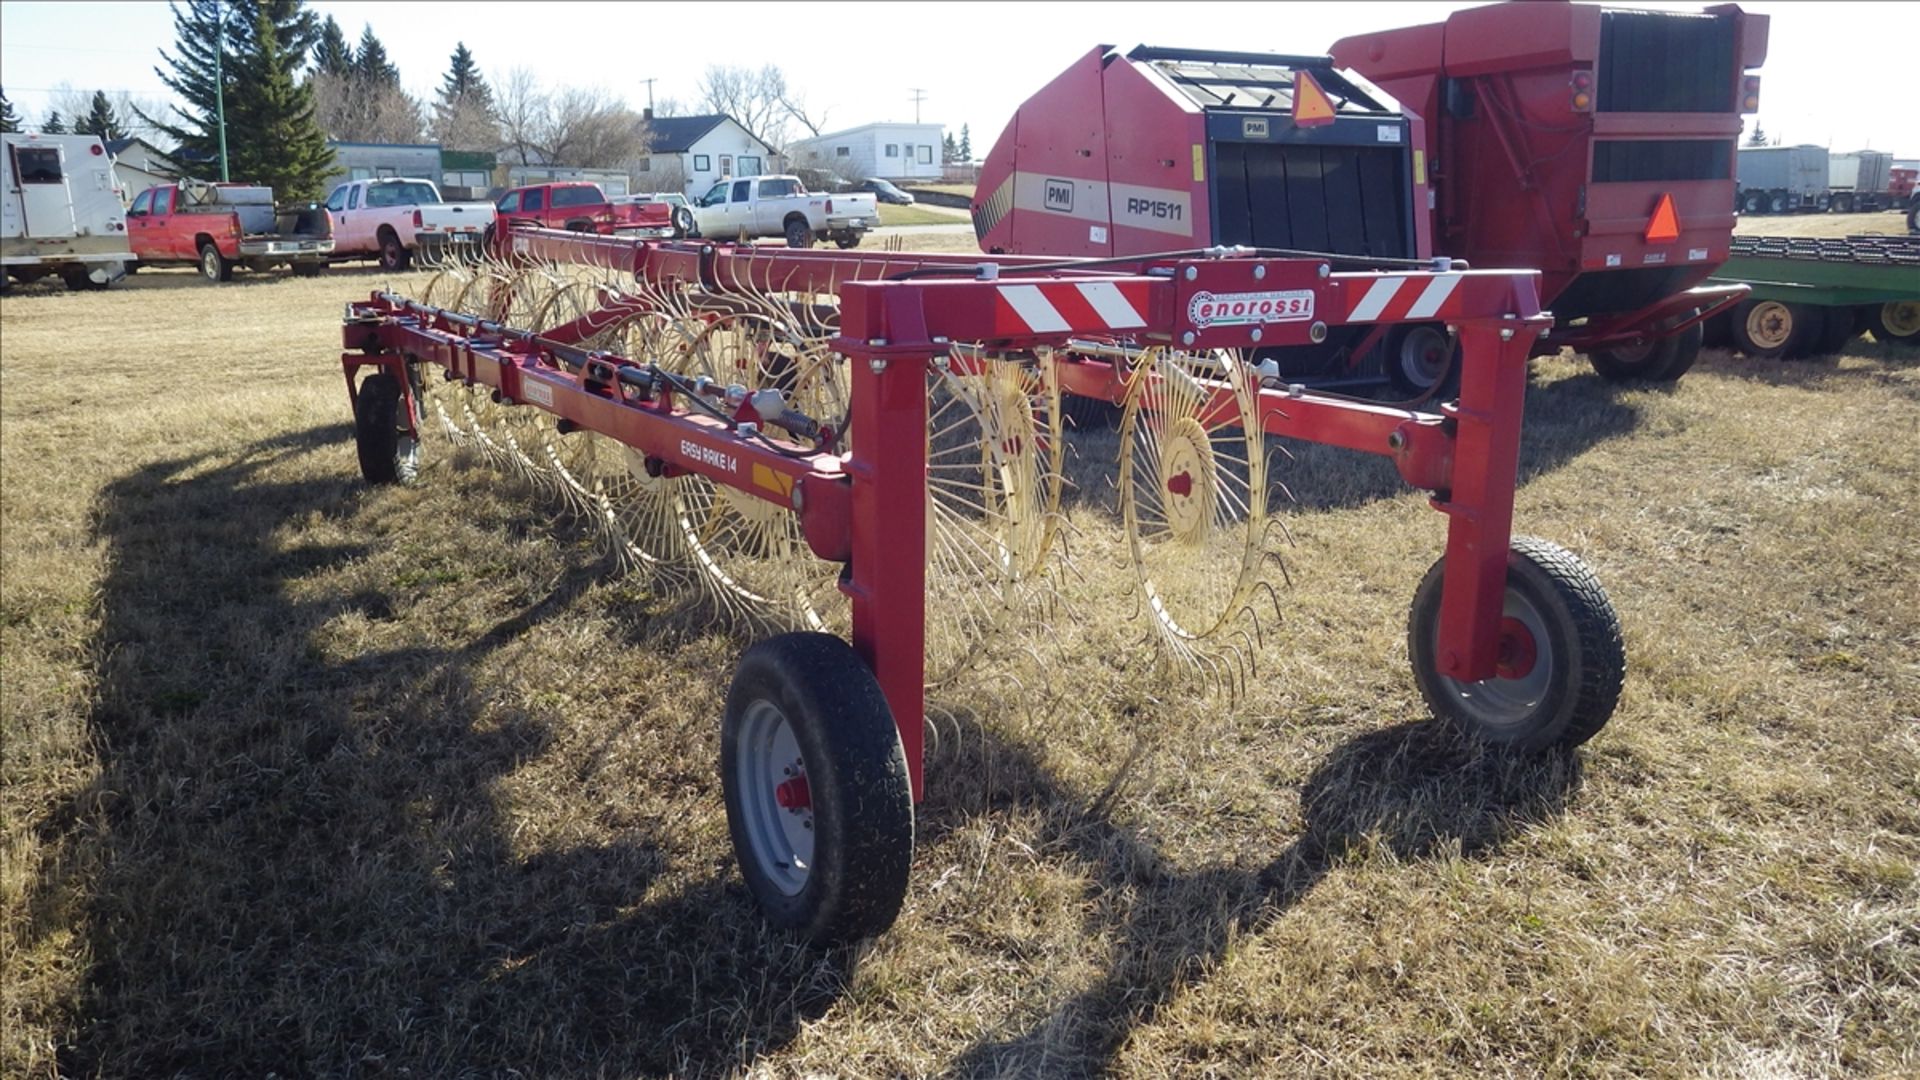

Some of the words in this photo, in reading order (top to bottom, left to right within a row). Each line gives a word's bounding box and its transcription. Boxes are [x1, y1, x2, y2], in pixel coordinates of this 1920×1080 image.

[1247, 122, 1265, 133] PMI
[1048, 186, 1070, 205] PMI
[1127, 197, 1182, 221] RP1511
[1200, 298, 1310, 317] enorossi
[681, 439, 702, 461] EASY
[702, 447, 726, 470] RAKE
[727, 455, 737, 474] 14
